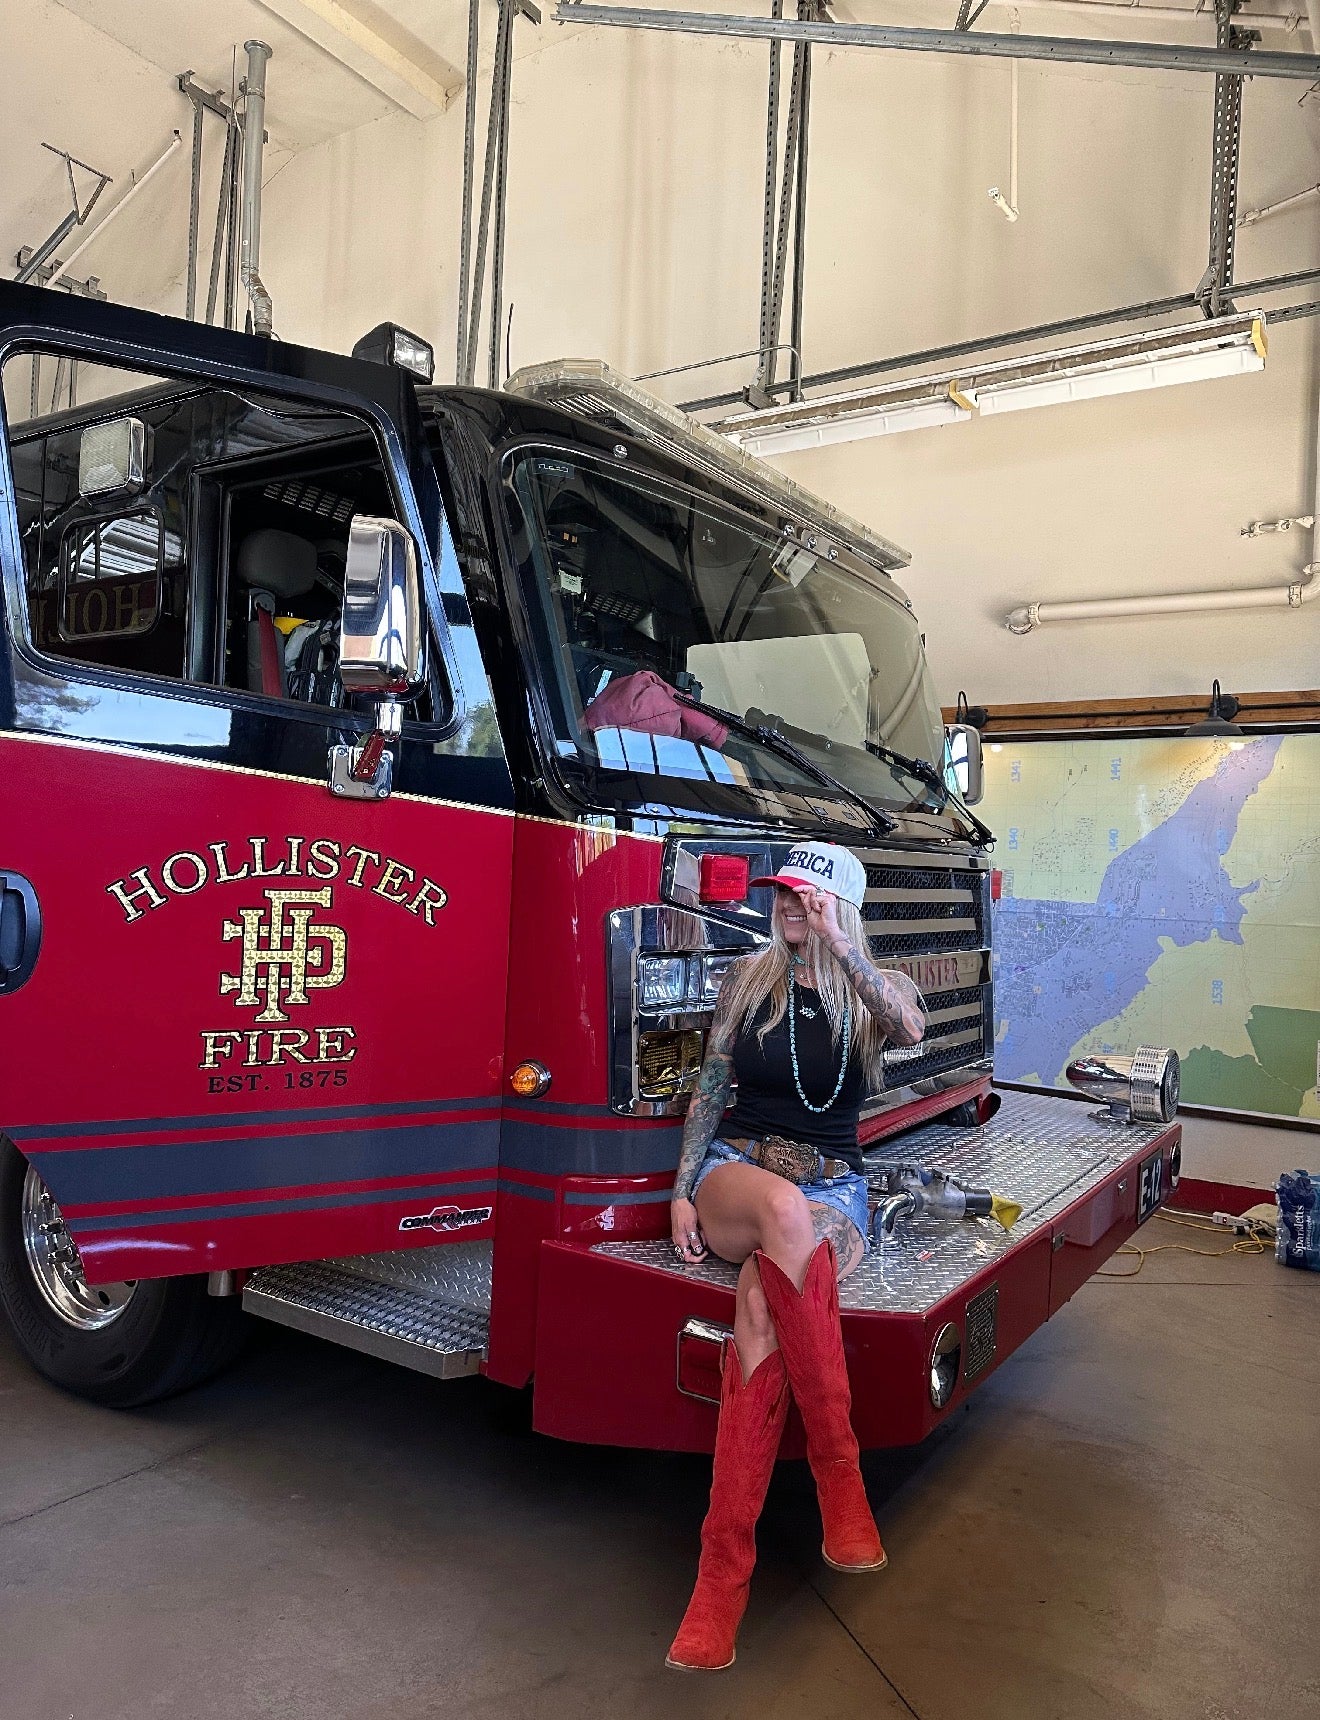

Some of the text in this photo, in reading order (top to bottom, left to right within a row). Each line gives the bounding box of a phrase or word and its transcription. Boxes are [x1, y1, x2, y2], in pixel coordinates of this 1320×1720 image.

[1110, 757, 1122, 782] 1441
[106, 836, 449, 927] HOLLISTER
[886, 957, 960, 988] LLISTER
[1210, 979, 1223, 1006] 1538
[199, 1026, 358, 1069] FIRE
[207, 1069, 348, 1094] EST. 1875
[1140, 1158, 1162, 1215] E-12
[1292, 1204, 1306, 1257] Sparkletts
